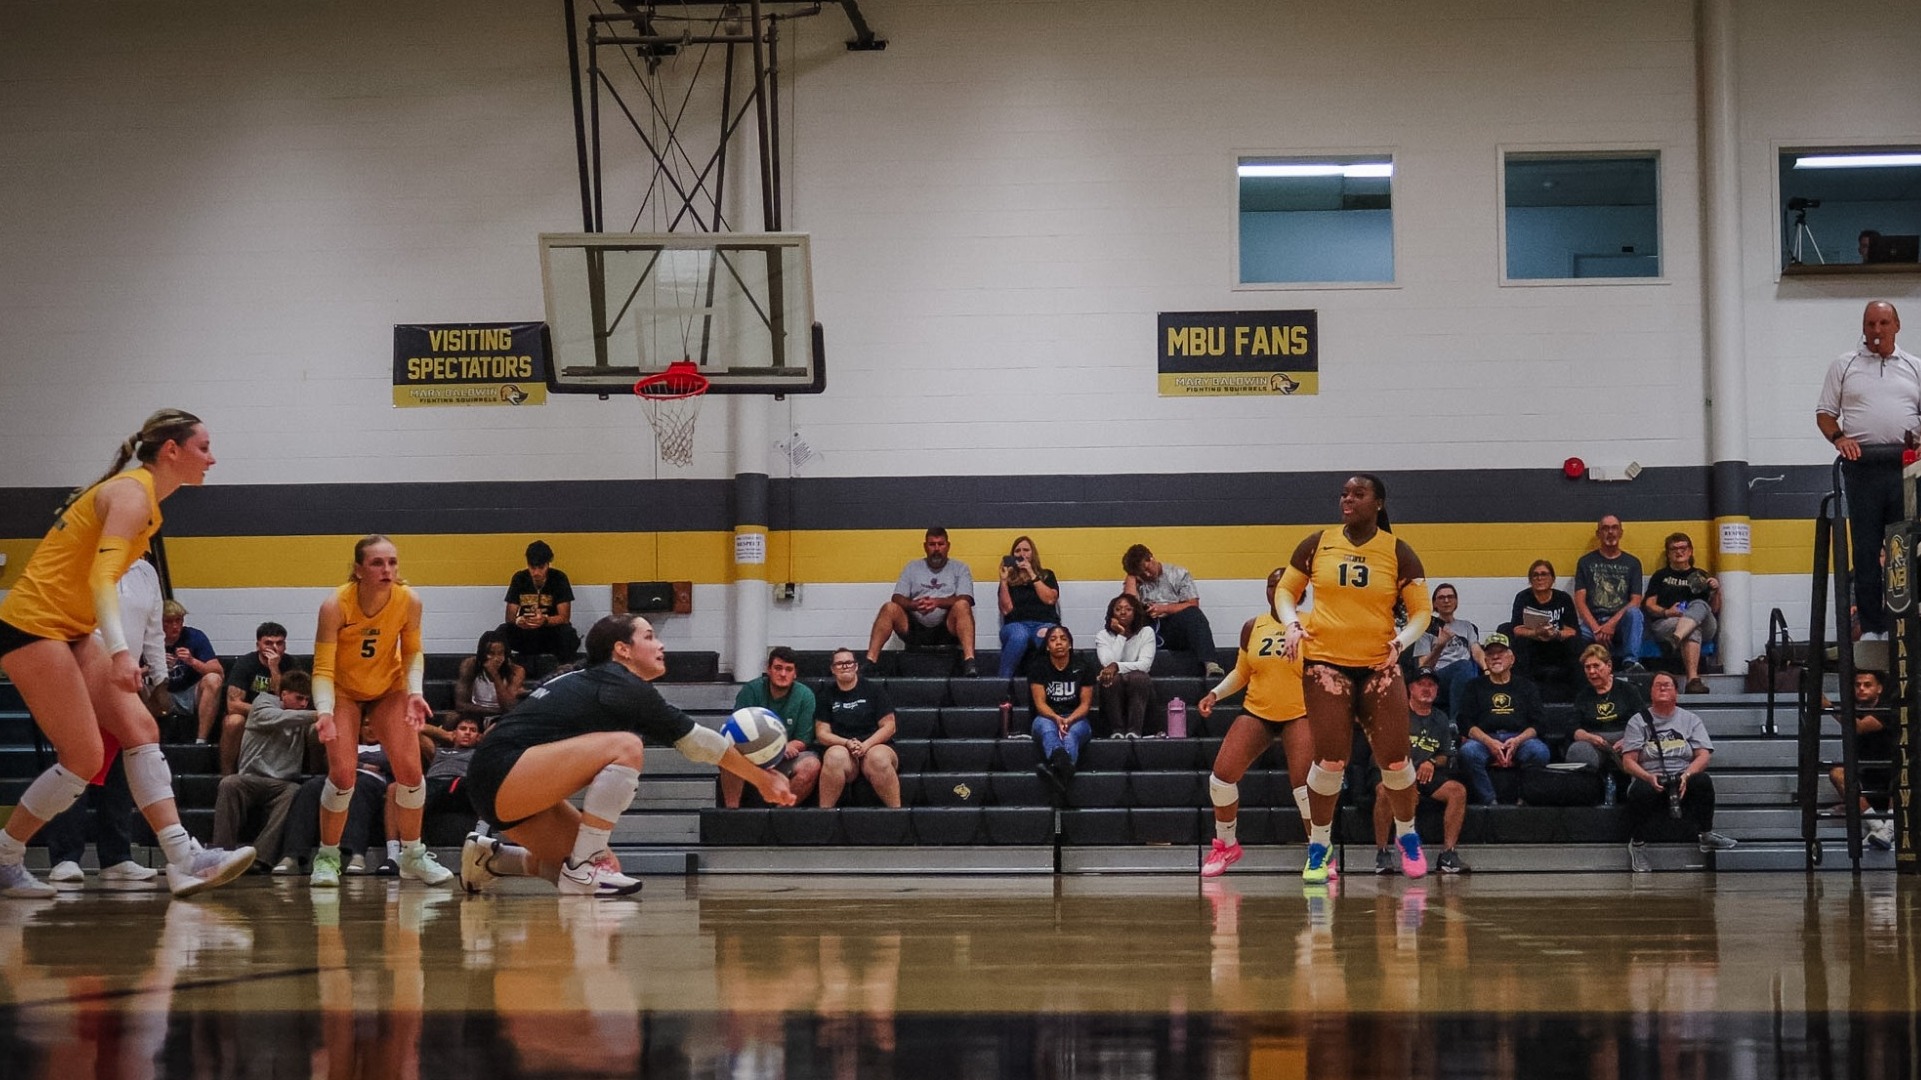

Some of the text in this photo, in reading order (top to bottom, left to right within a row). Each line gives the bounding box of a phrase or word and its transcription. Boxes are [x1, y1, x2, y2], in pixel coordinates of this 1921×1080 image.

[429, 328, 512, 352] VISITING
[1167, 325, 1309, 357] MBU FANS
[407, 356, 532, 380] SPECTATORS
[409, 387, 498, 398] MARY BALDWIN
[1175, 376, 1268, 386] MARY BALDWIN
[1338, 563, 1370, 588] 13
[360, 638, 377, 659] 5
